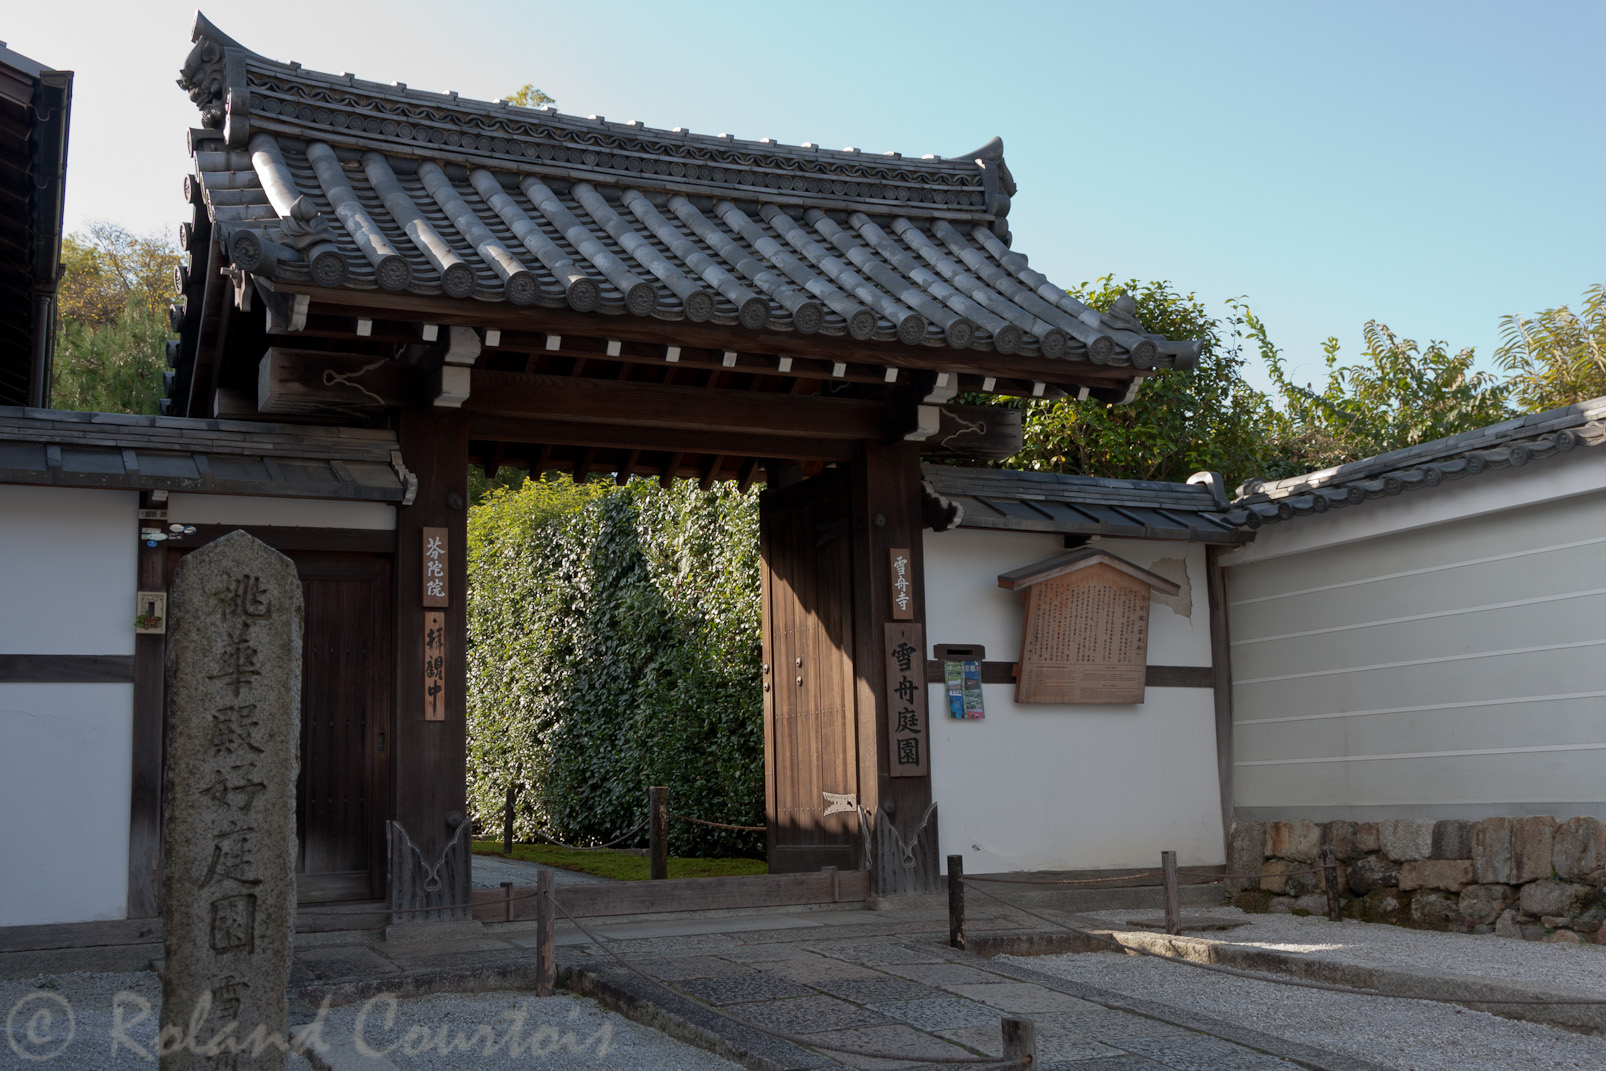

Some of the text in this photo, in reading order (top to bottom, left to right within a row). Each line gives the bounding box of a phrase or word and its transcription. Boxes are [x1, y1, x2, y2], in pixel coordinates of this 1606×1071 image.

[425, 536, 446, 597] 芬陀院
[893, 555, 910, 611] 雪舟寺
[425, 627, 444, 717] 拝観中
[891, 642, 922, 767] 雪舟庭園
